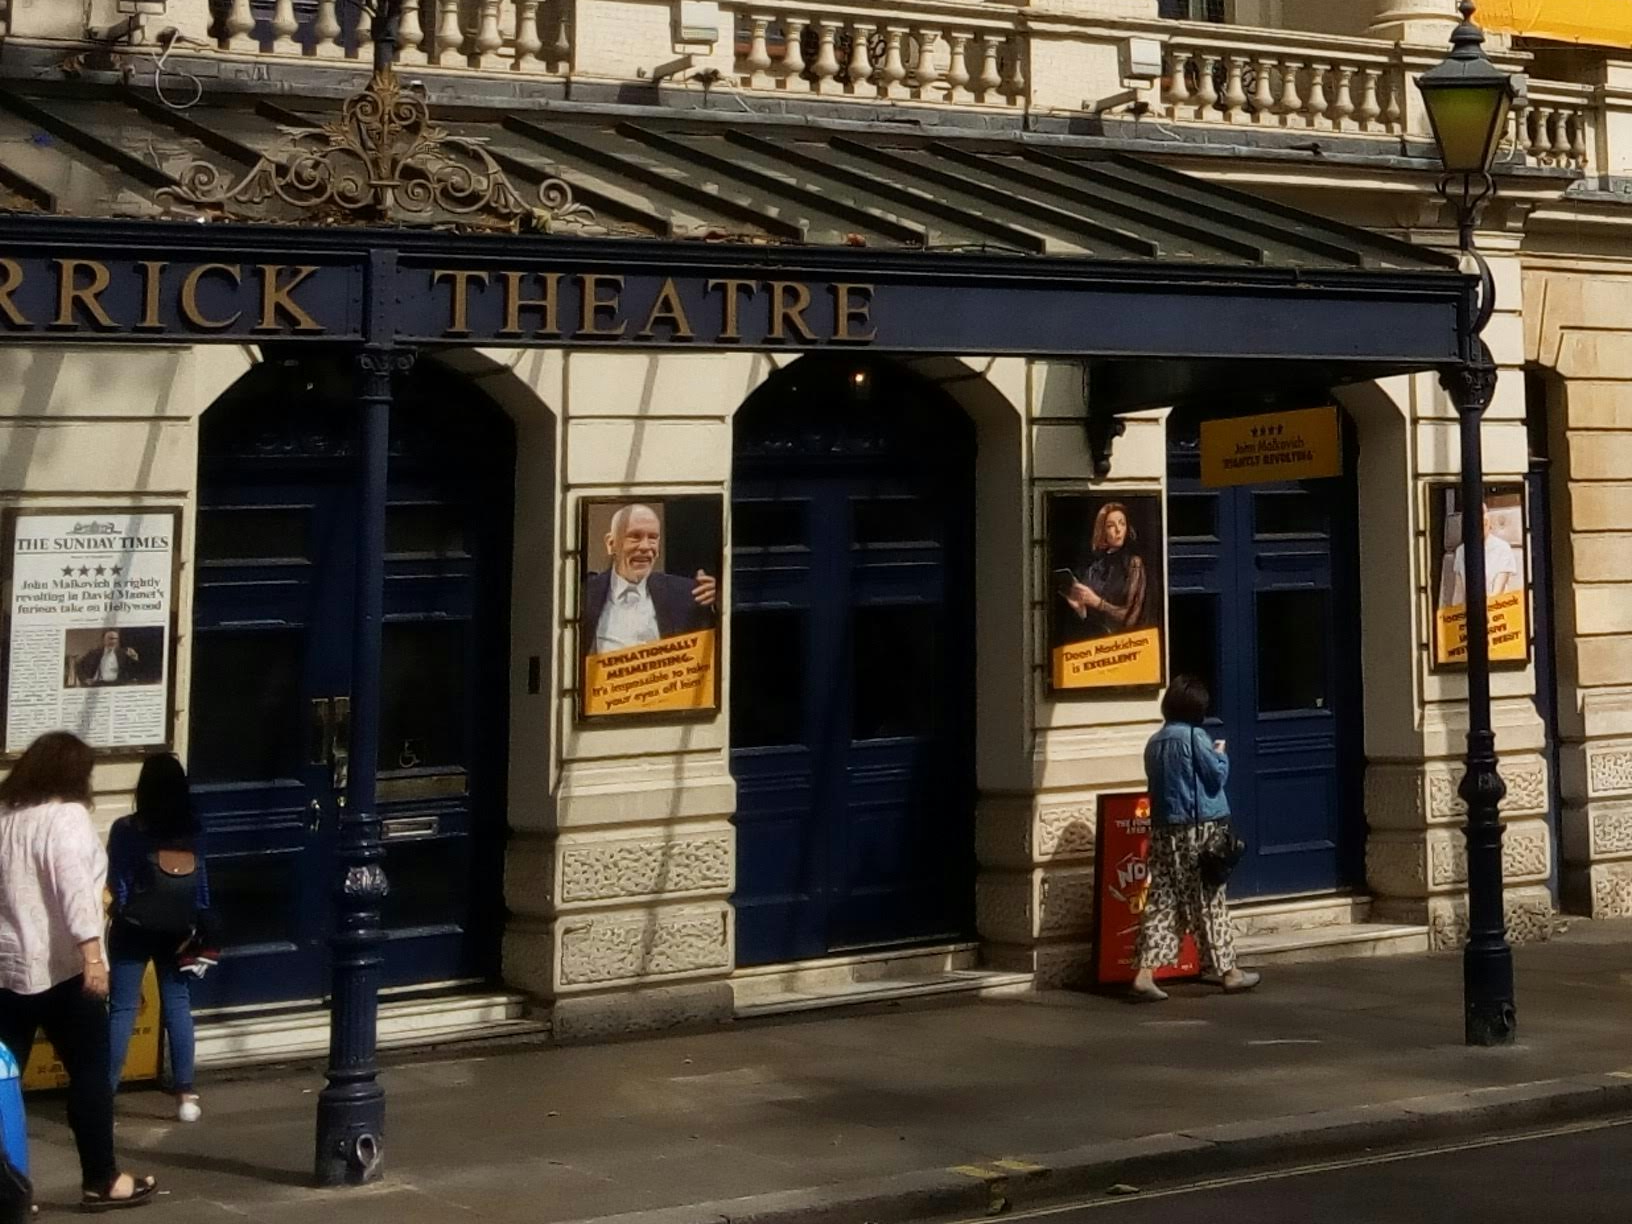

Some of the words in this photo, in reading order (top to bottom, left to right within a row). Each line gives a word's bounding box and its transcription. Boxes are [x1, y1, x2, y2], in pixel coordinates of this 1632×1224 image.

[0, 257, 326, 330] RRICK
[434, 270, 877, 342] THEATRE
[16, 538, 49, 550] THE
[53, 537, 118, 550] SUNDAY
[119, 536, 169, 549] TIMES
[21, 580, 48, 591] John
[53, 577, 110, 590] Malkovich
[16, 592, 65, 603] revolting
[82, 589, 114, 601] David
[18, 603, 58, 615] furious
[60, 603, 83, 613] take
[104, 600, 162, 615] Hollywood
